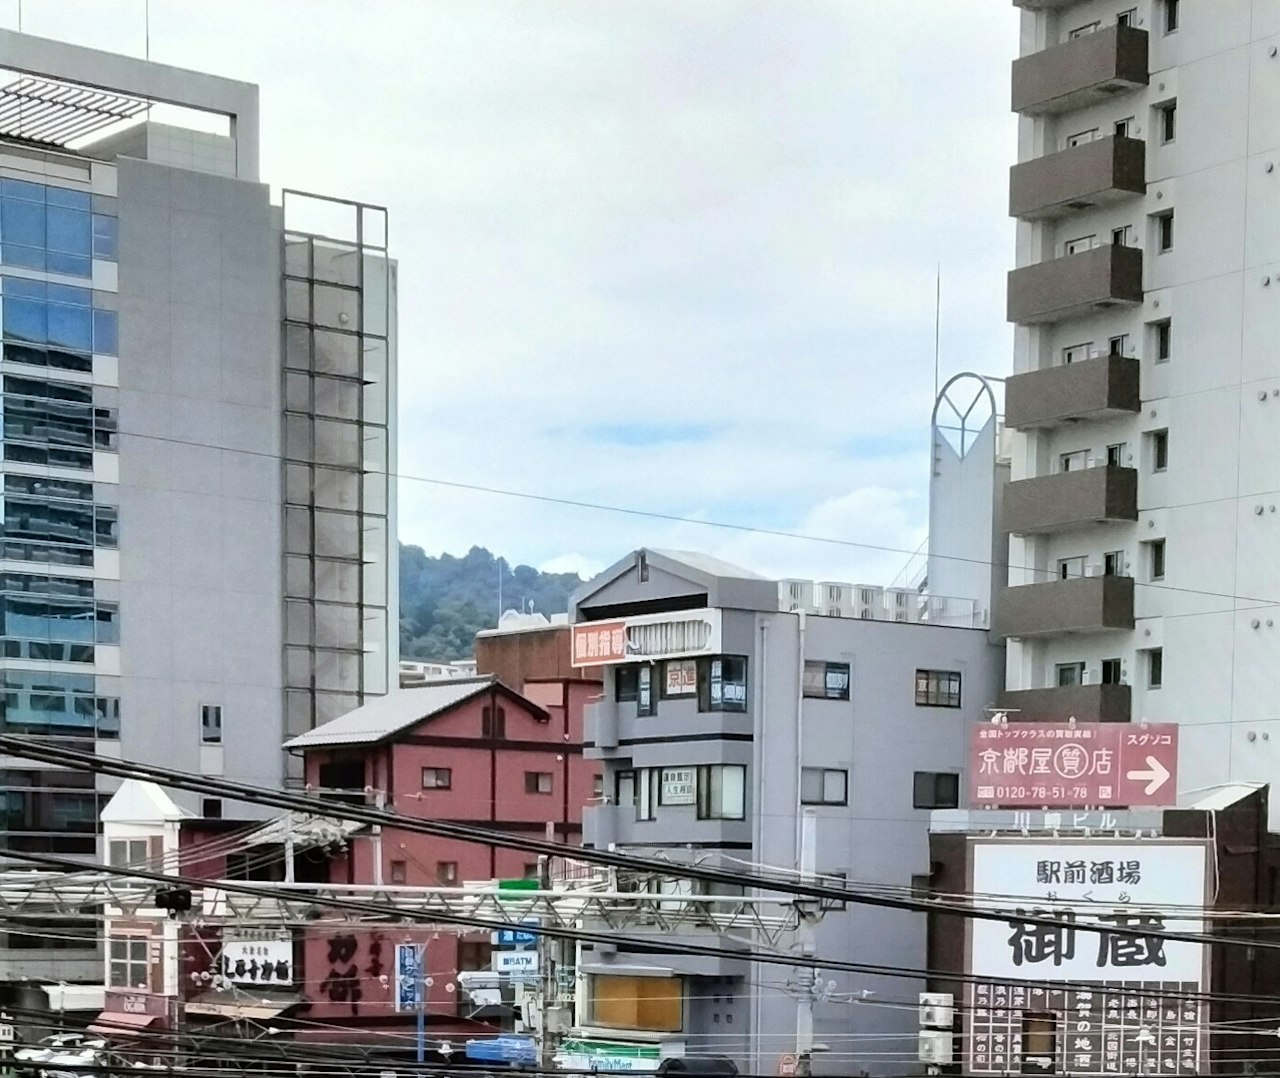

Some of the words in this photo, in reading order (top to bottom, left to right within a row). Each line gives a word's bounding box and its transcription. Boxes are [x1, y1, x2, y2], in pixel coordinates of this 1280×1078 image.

[1127, 734, 1172, 746] スグソコ
[978, 743, 1114, 779] 京都屋質店
[997, 786, 1088, 799] 0120-78-51-78
[1036, 860, 1141, 885] 駅前酒場
[1007, 907, 1167, 967] 御蔵
